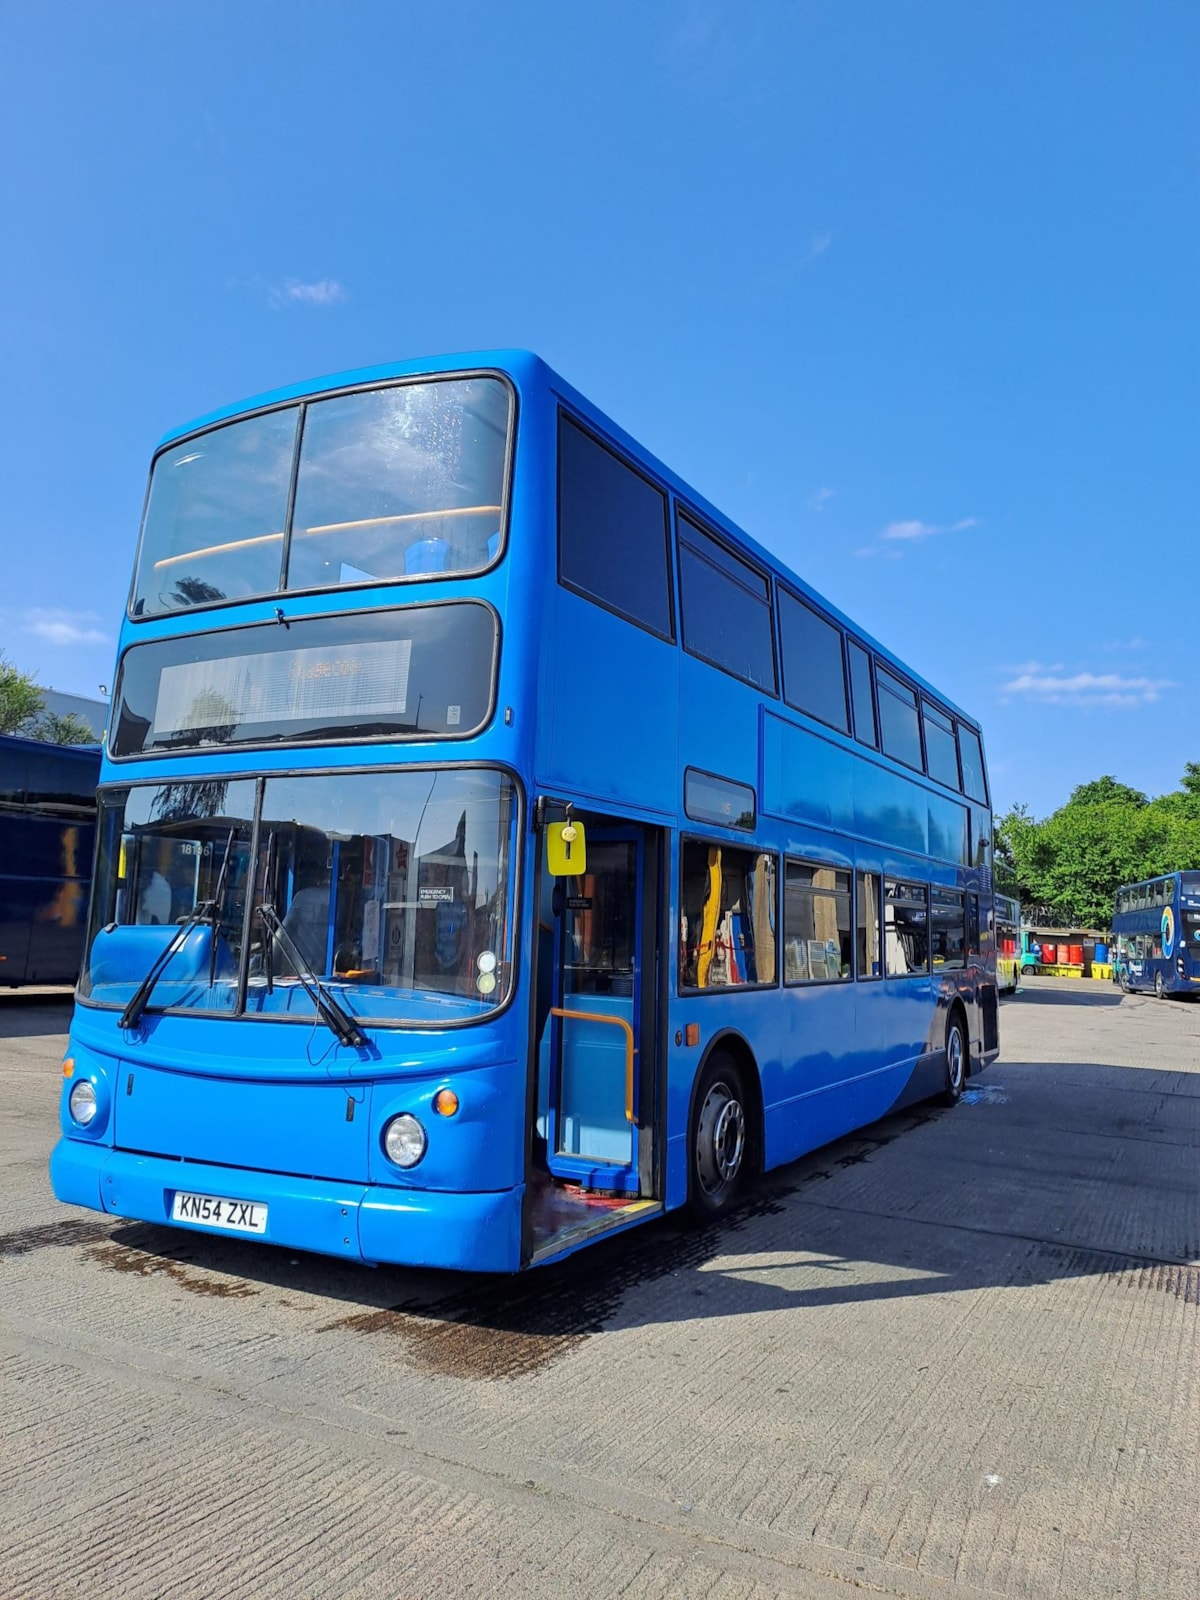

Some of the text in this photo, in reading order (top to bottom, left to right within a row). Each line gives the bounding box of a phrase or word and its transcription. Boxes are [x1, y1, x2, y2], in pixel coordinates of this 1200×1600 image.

[181, 843, 210, 856] 18196
[180, 1195, 259, 1228] KN54 ZXL
